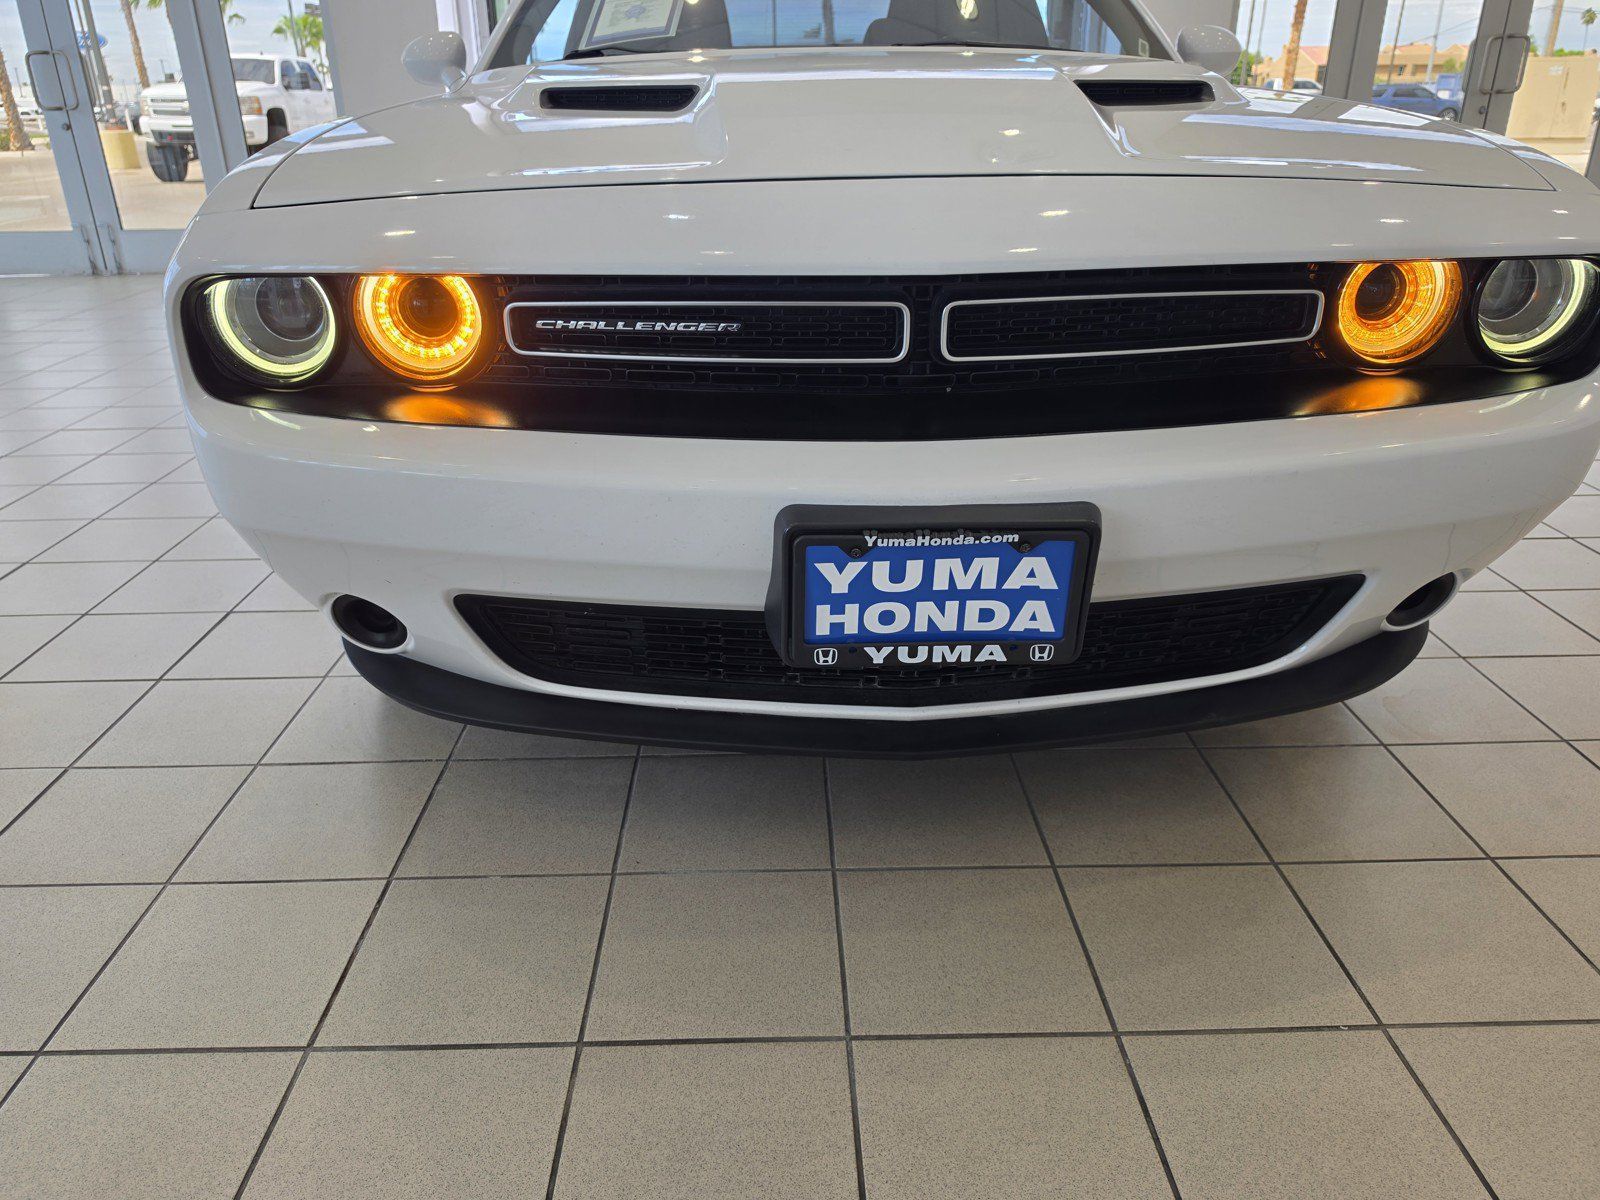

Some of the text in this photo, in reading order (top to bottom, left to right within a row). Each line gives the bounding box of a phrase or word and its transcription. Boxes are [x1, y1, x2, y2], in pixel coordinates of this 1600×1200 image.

[535, 319, 742, 332] CHALLENGER
[864, 533, 1019, 547] YumaHonda.com
[813, 556, 1059, 594] YUMA
[815, 600, 1056, 635] HONDA
[863, 644, 1008, 664] YUMA
